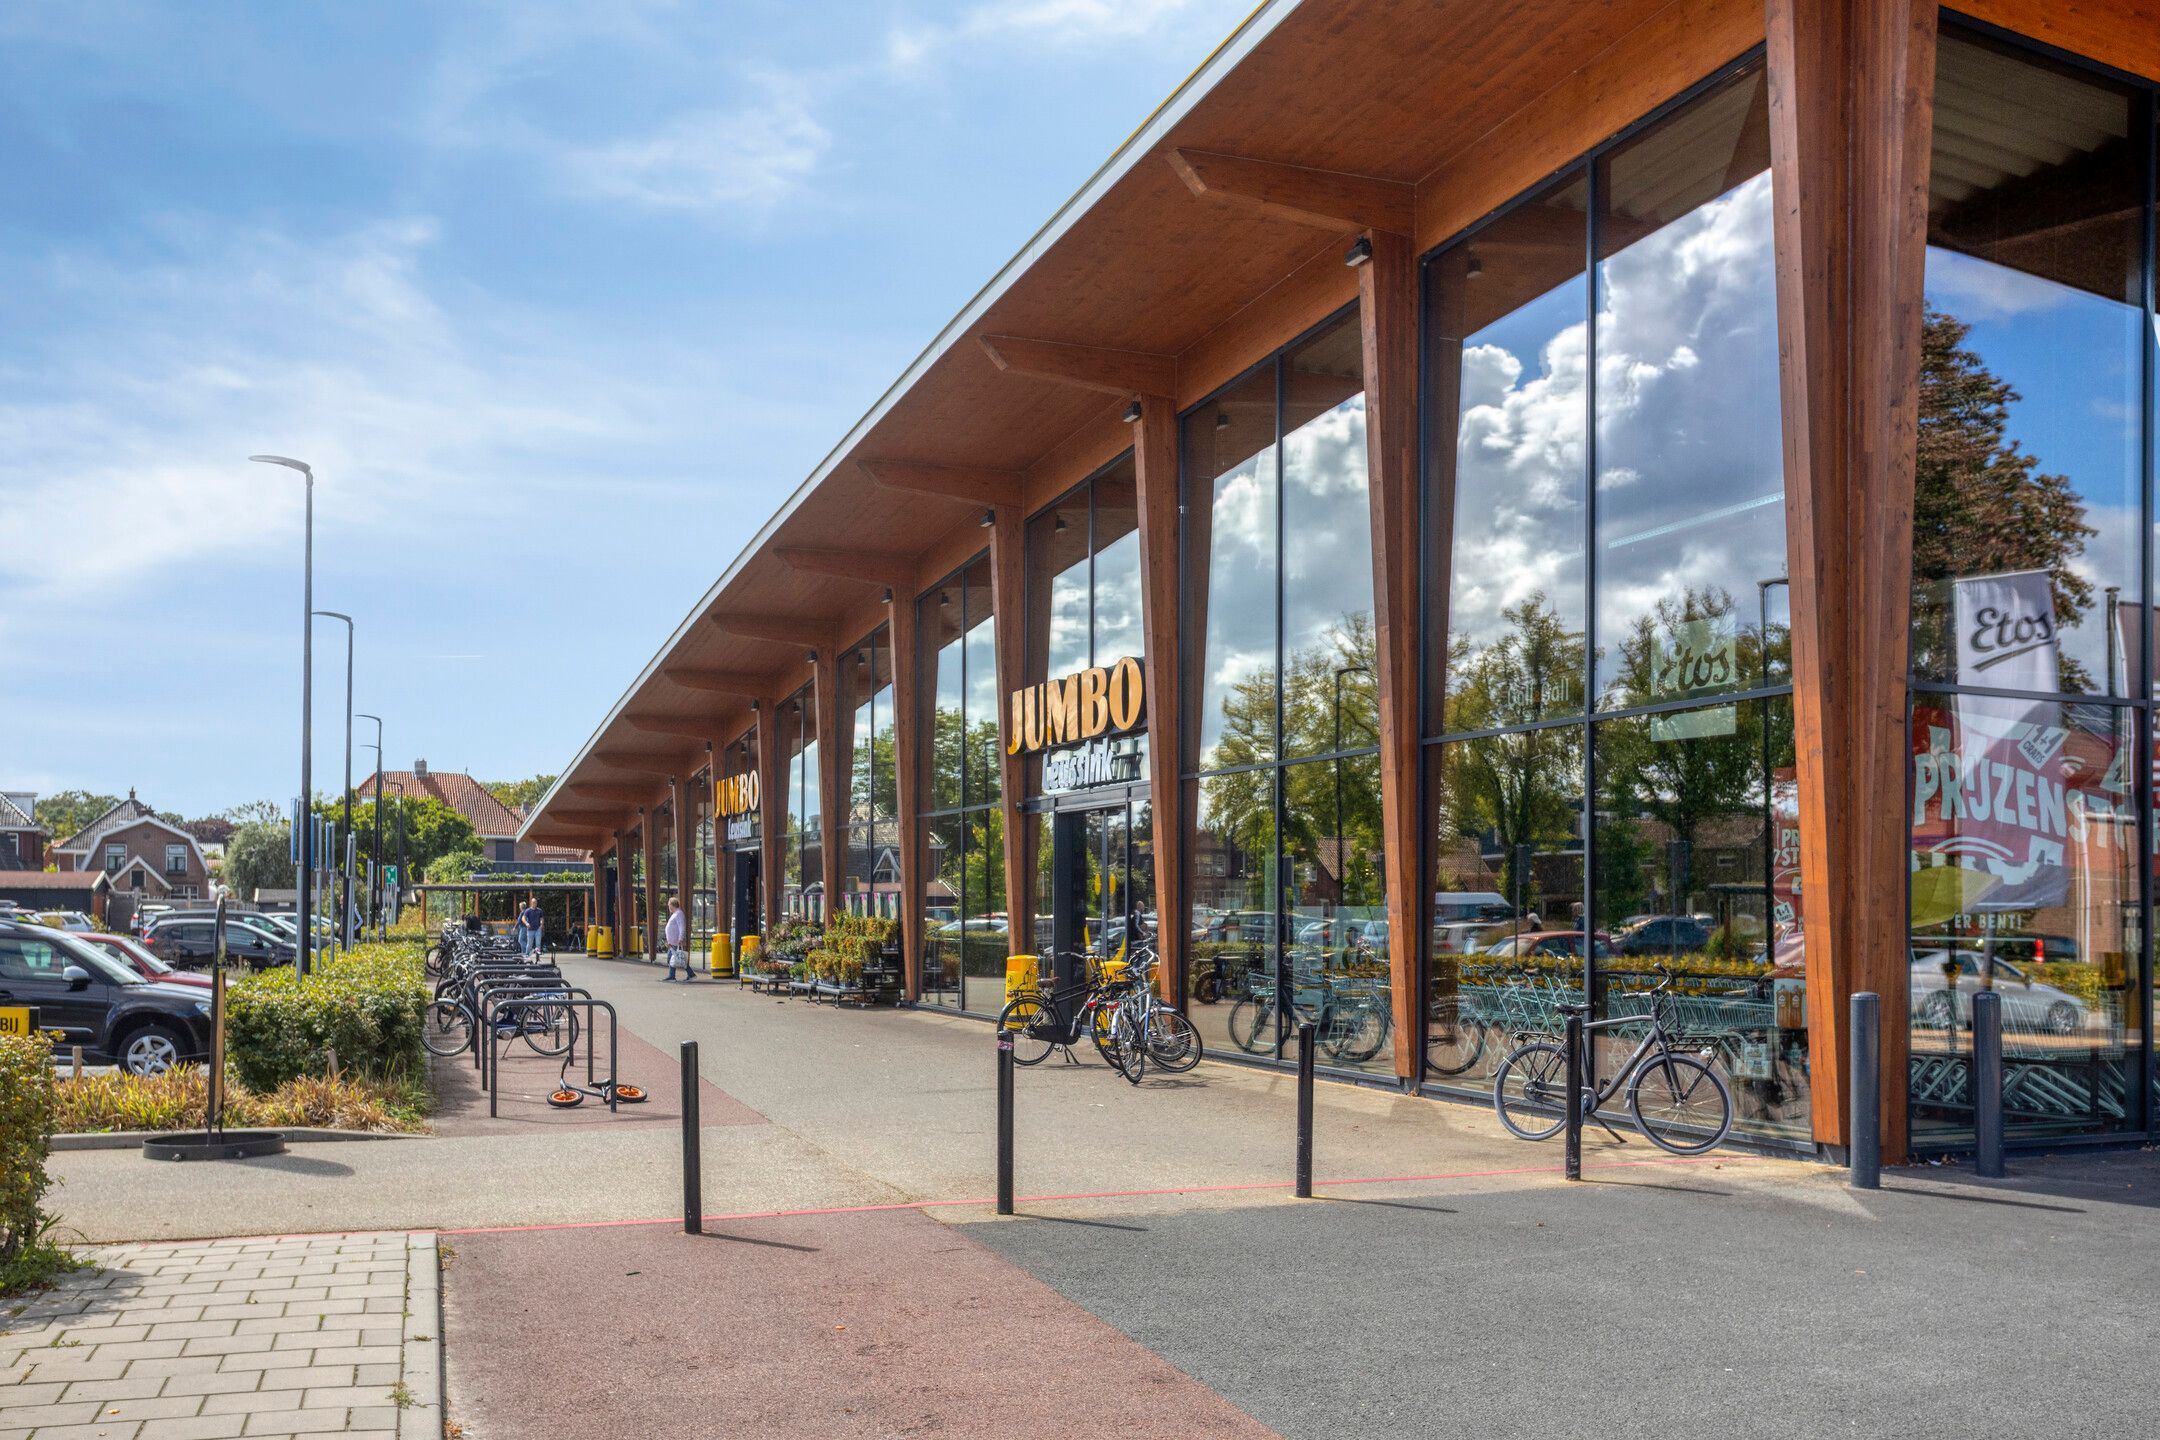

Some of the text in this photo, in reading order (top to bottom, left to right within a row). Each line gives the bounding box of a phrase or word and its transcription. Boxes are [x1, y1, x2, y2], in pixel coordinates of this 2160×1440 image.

[1970, 608, 2051, 653] Etos
[1657, 641, 1730, 693] Etos
[1007, 656, 1143, 755] JUMBO
[715, 770, 759, 818] JUMBO
